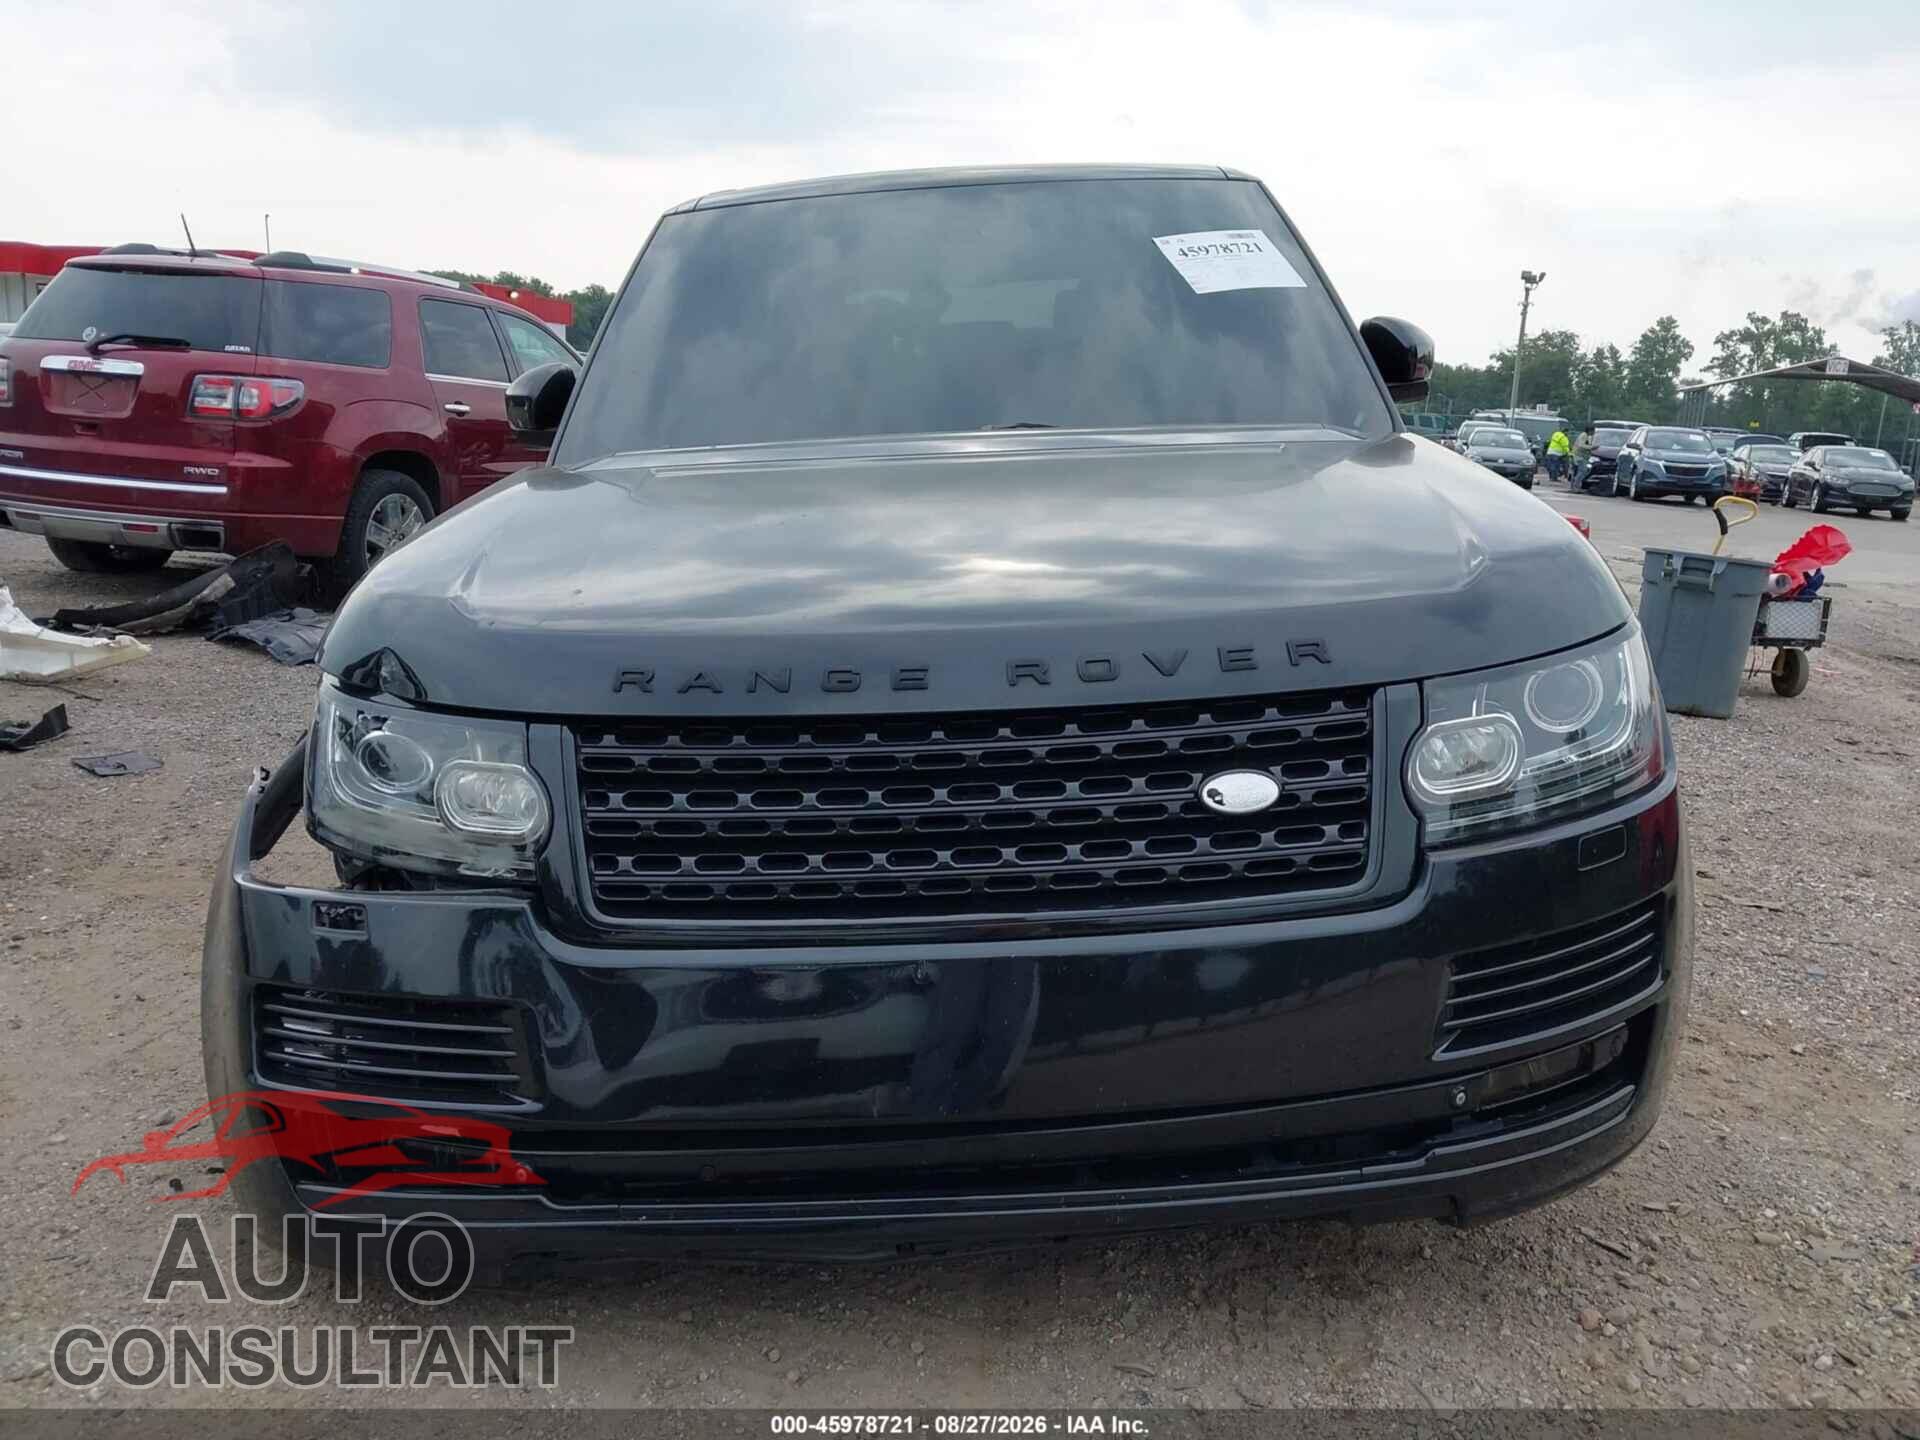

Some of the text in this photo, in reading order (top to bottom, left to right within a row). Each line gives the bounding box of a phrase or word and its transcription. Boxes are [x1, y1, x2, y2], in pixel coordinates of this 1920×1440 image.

[1177, 242, 1263, 258] 45978721
[612, 638, 1333, 694] RANGE ROVER
